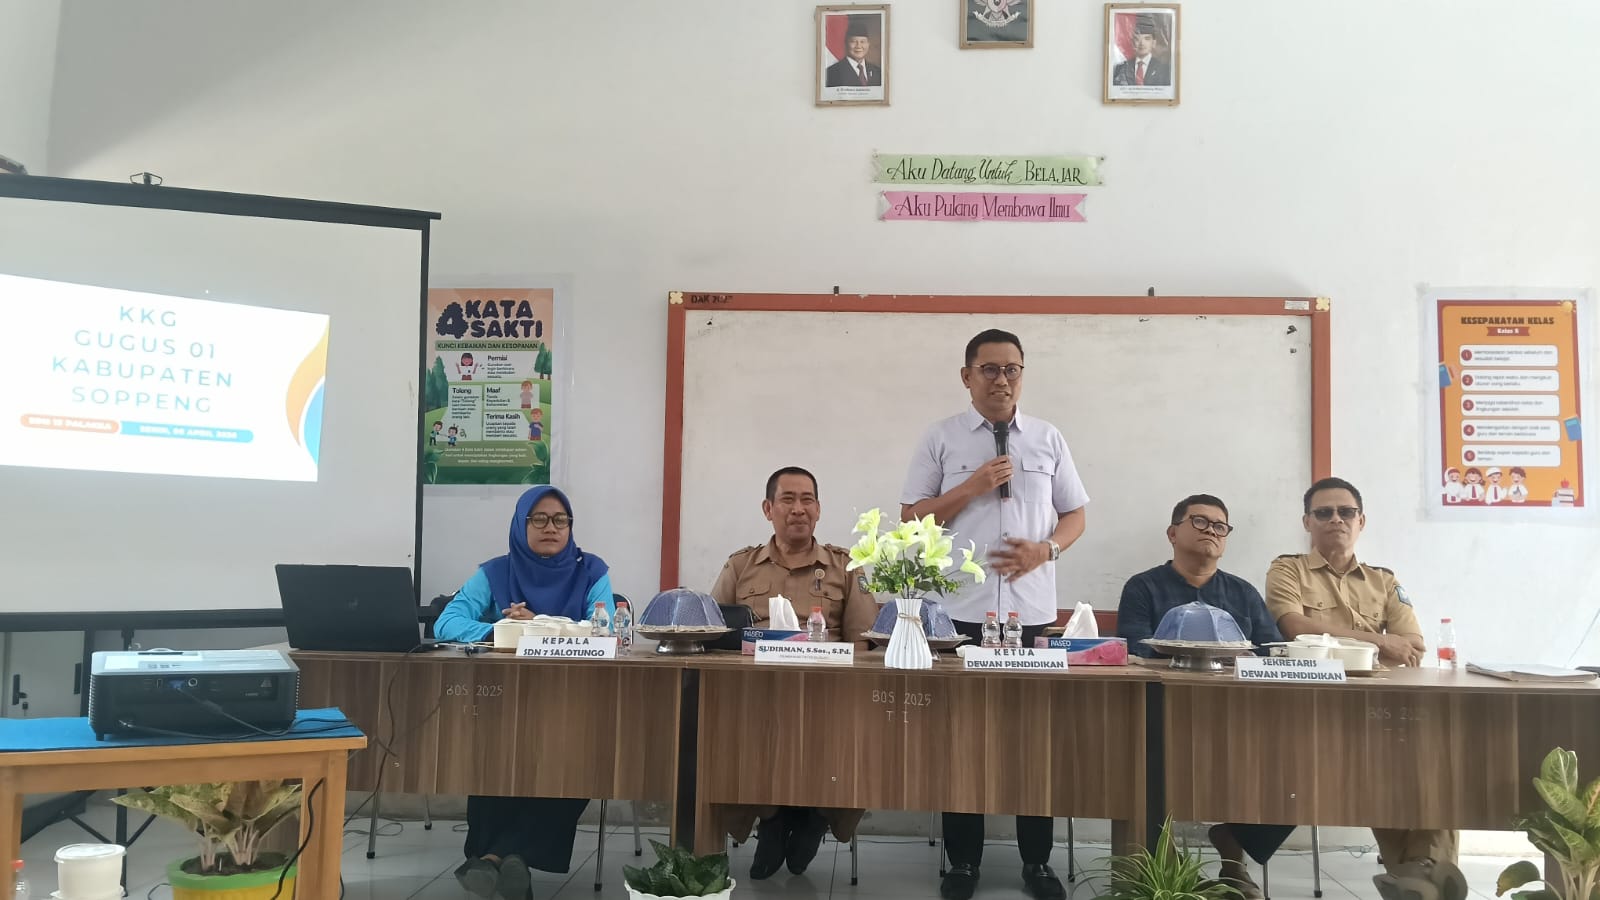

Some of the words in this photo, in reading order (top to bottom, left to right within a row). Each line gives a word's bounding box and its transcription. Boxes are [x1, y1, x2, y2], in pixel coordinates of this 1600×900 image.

[887, 158, 926, 181] Aku
[931, 158, 976, 183] Datang
[979, 158, 1022, 183] Untuk
[1025, 160, 1088, 185] BELAJAR
[895, 195, 931, 217] Aku
[934, 195, 978, 219] Pulang
[982, 195, 1045, 218] Membawa
[1049, 196, 1070, 218] Ilmu
[119, 305, 177, 327] KKG
[436, 301, 469, 339] 4
[465, 299, 533, 319] KATA
[1461, 316, 1525, 325] KESEPAKATAN
[1527, 316, 1555, 325] KELAS
[471, 319, 543, 338] SAKTI
[74, 329, 176, 356] GUGUS
[189, 342, 215, 359] 01
[52, 356, 233, 388] KABUPATEN
[452, 387, 472, 395] Tolong
[71, 386, 211, 413] SOPPENG
[542, 637, 590, 645] KEPALA
[1050, 639, 1072, 647] PASEO
[523, 648, 542, 656] SDN
[550, 648, 605, 657] SALOTUNGO
[758, 645, 805, 654] SUDIRMAN,
[994, 648, 1035, 656] KETUA
[967, 660, 1003, 668] DEWAN
[1005, 660, 1065, 669] PENDIDIKAN
[1262, 658, 1317, 668] SEKRETARIS
[1240, 669, 1279, 679] DEWAN
[1280, 671, 1343, 681] PENDIDIKAN
[476, 684, 503, 697] 2025
[872, 689, 895, 704] BOS
[903, 692, 932, 706] 2025
